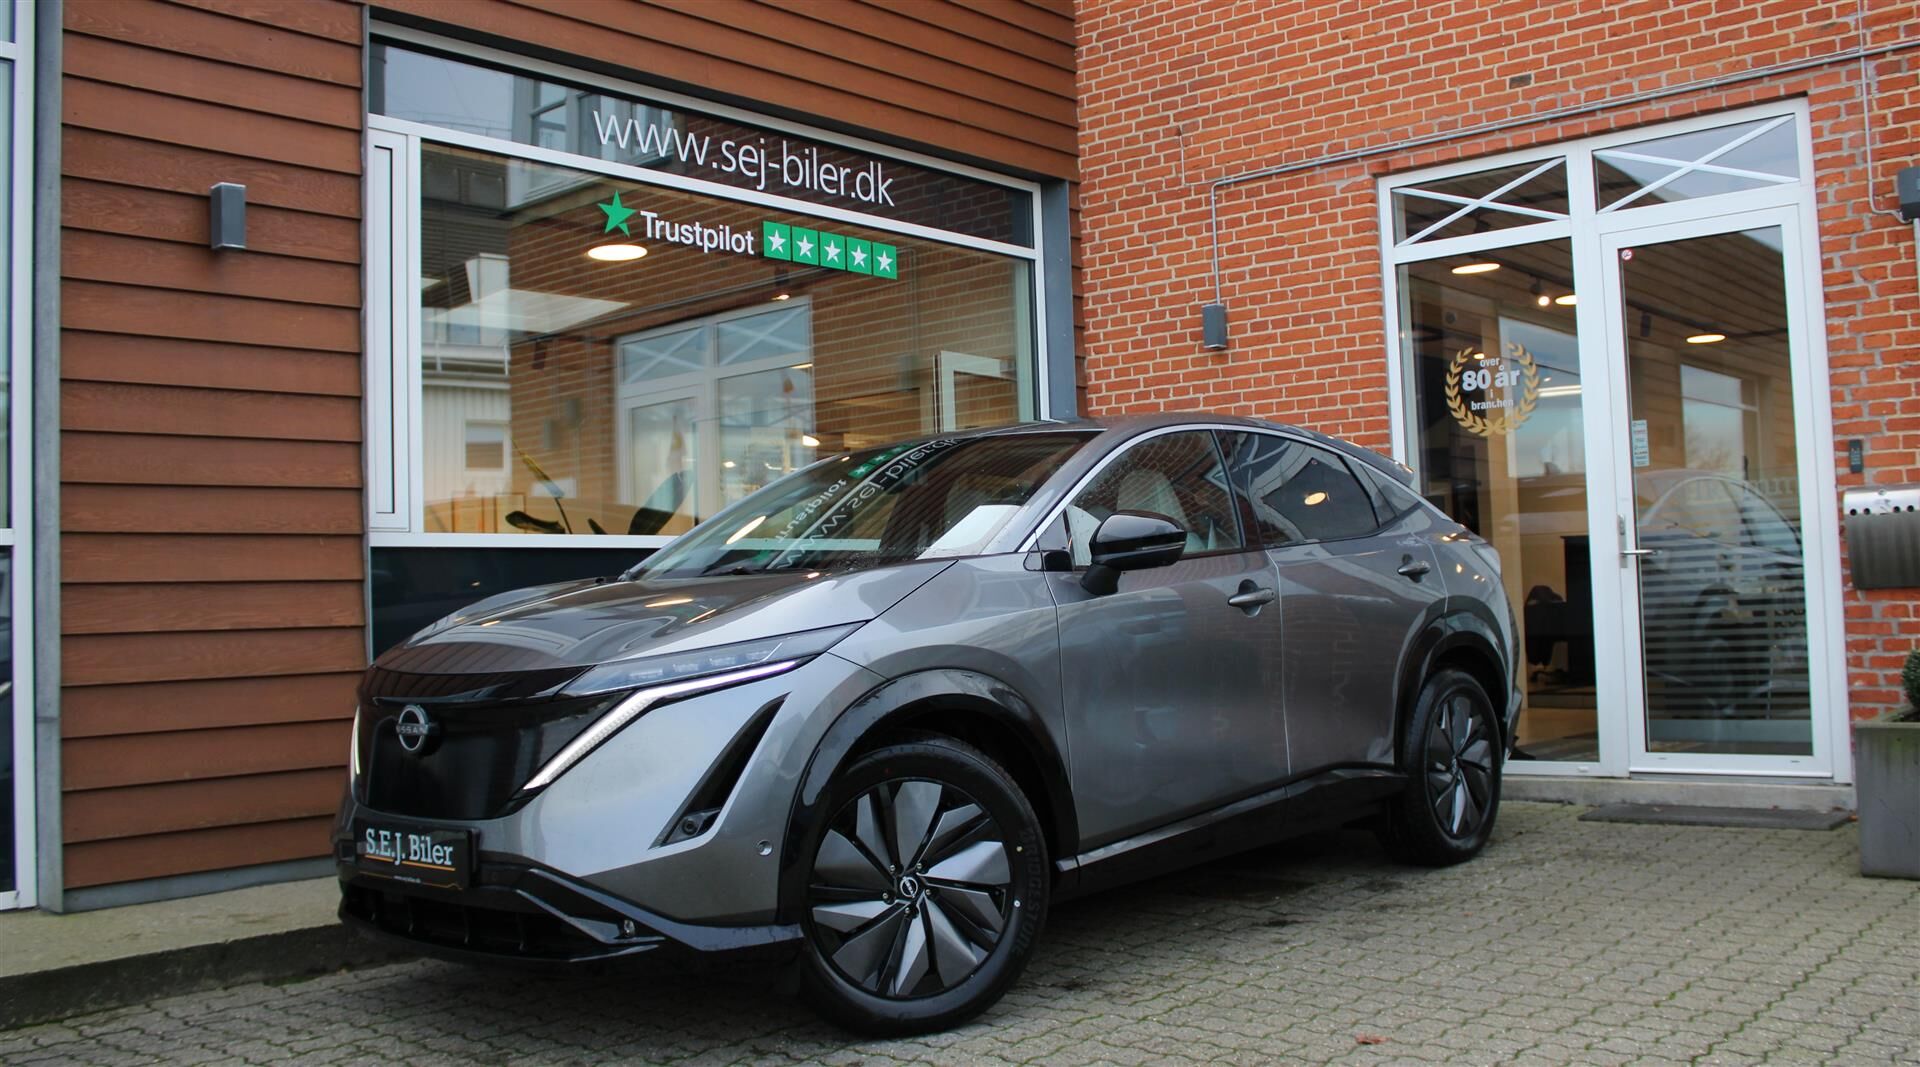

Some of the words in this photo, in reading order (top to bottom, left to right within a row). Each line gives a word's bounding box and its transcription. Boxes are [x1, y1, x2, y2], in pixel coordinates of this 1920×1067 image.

[592, 110, 896, 207] www.sej-biler.dk
[640, 210, 755, 255] Trustpilot
[1462, 368, 1492, 391] 80
[1494, 364, 1521, 388] år
[1479, 357, 1501, 367] over
[365, 828, 406, 866] S.E.J.
[408, 834, 454, 866] Biler
